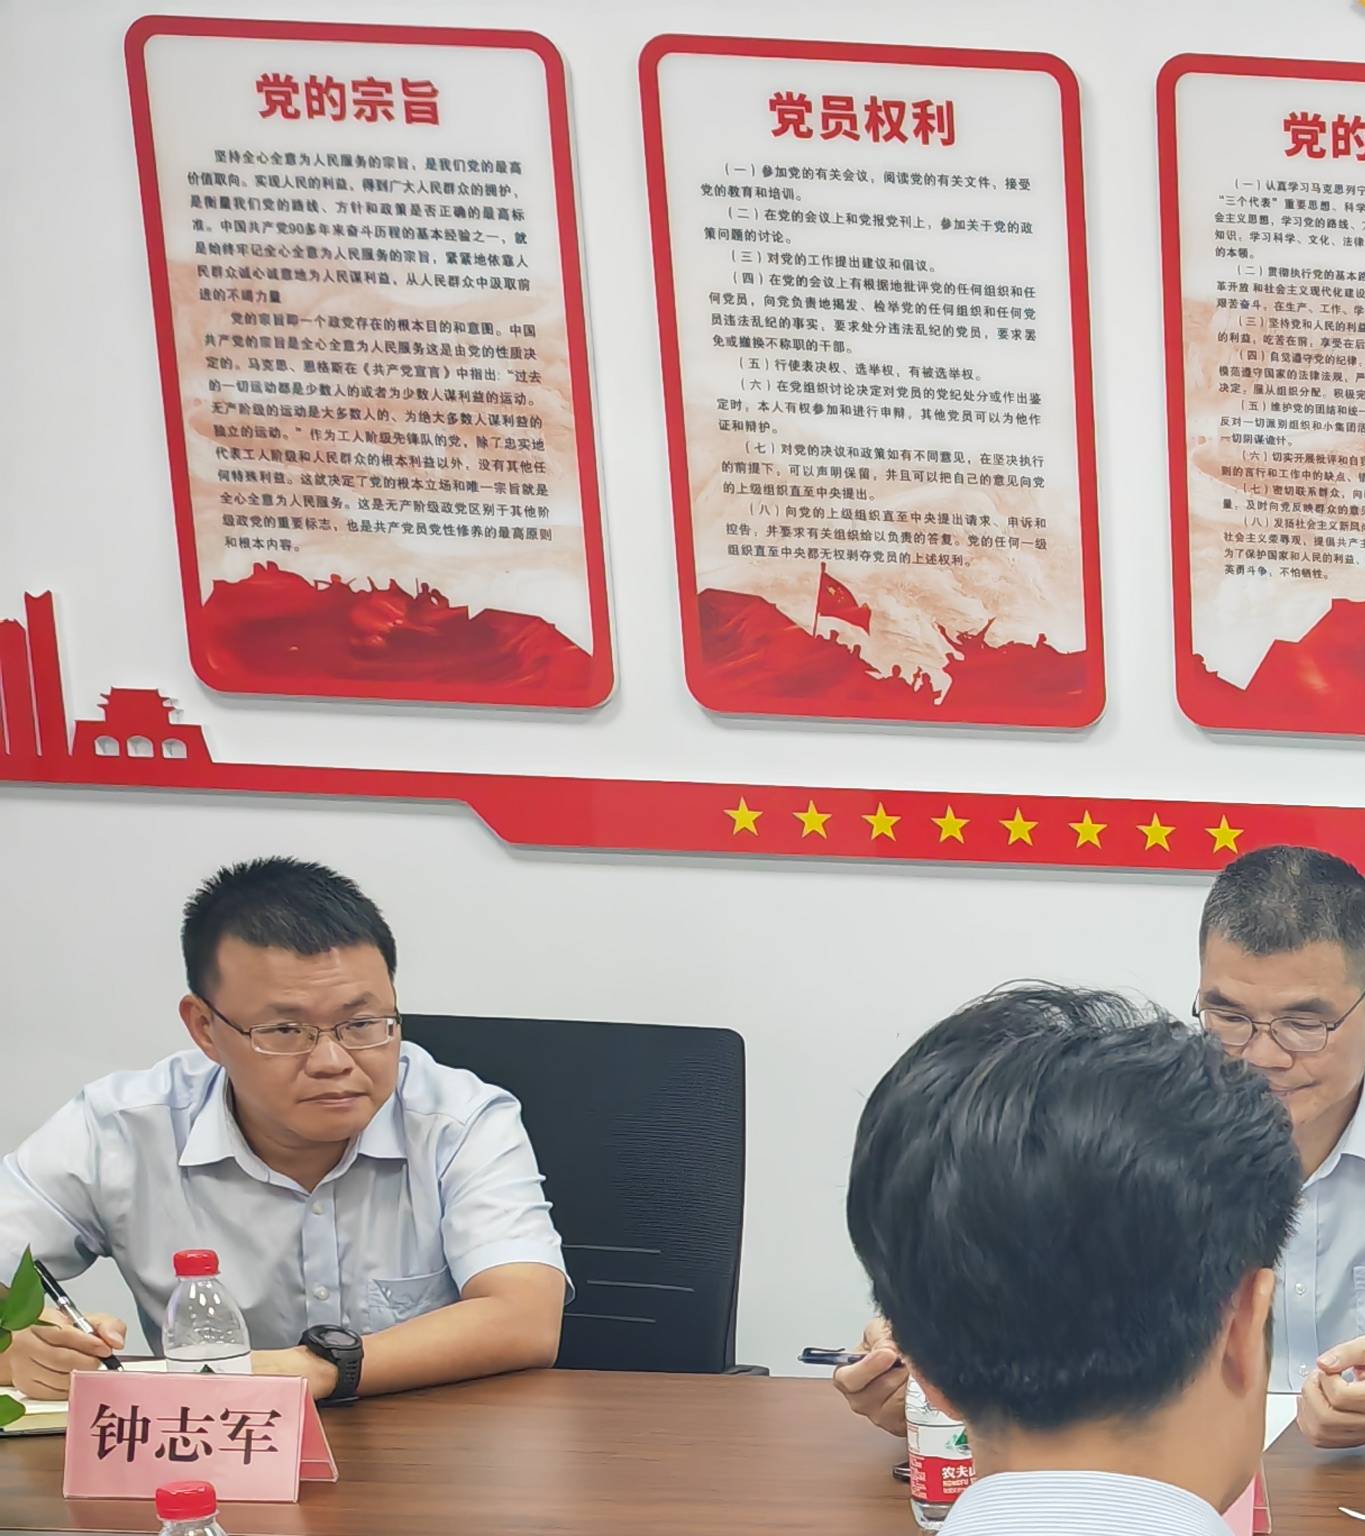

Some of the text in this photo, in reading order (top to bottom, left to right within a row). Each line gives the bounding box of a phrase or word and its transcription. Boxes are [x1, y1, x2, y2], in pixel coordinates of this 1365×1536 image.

[255, 72, 441, 125] 党的宗旨
[768, 91, 957, 146] 党员权利
[700, 184, 801, 201] 党的教育和培训。
[704, 226, 791, 244] 策问题的讨论。
[1215, 247, 1255, 259] 的本领。
[713, 334, 852, 353] 免或撤换不称职的干部。
[719, 419, 779, 434] 证和辩护。
[723, 481, 876, 501] 的上级组织直至中央提出。
[224, 536, 300, 552] 和根本内容。
[90, 1403, 284, 1465] 钟志军
[942, 1465, 976, 1479] 农夫山
